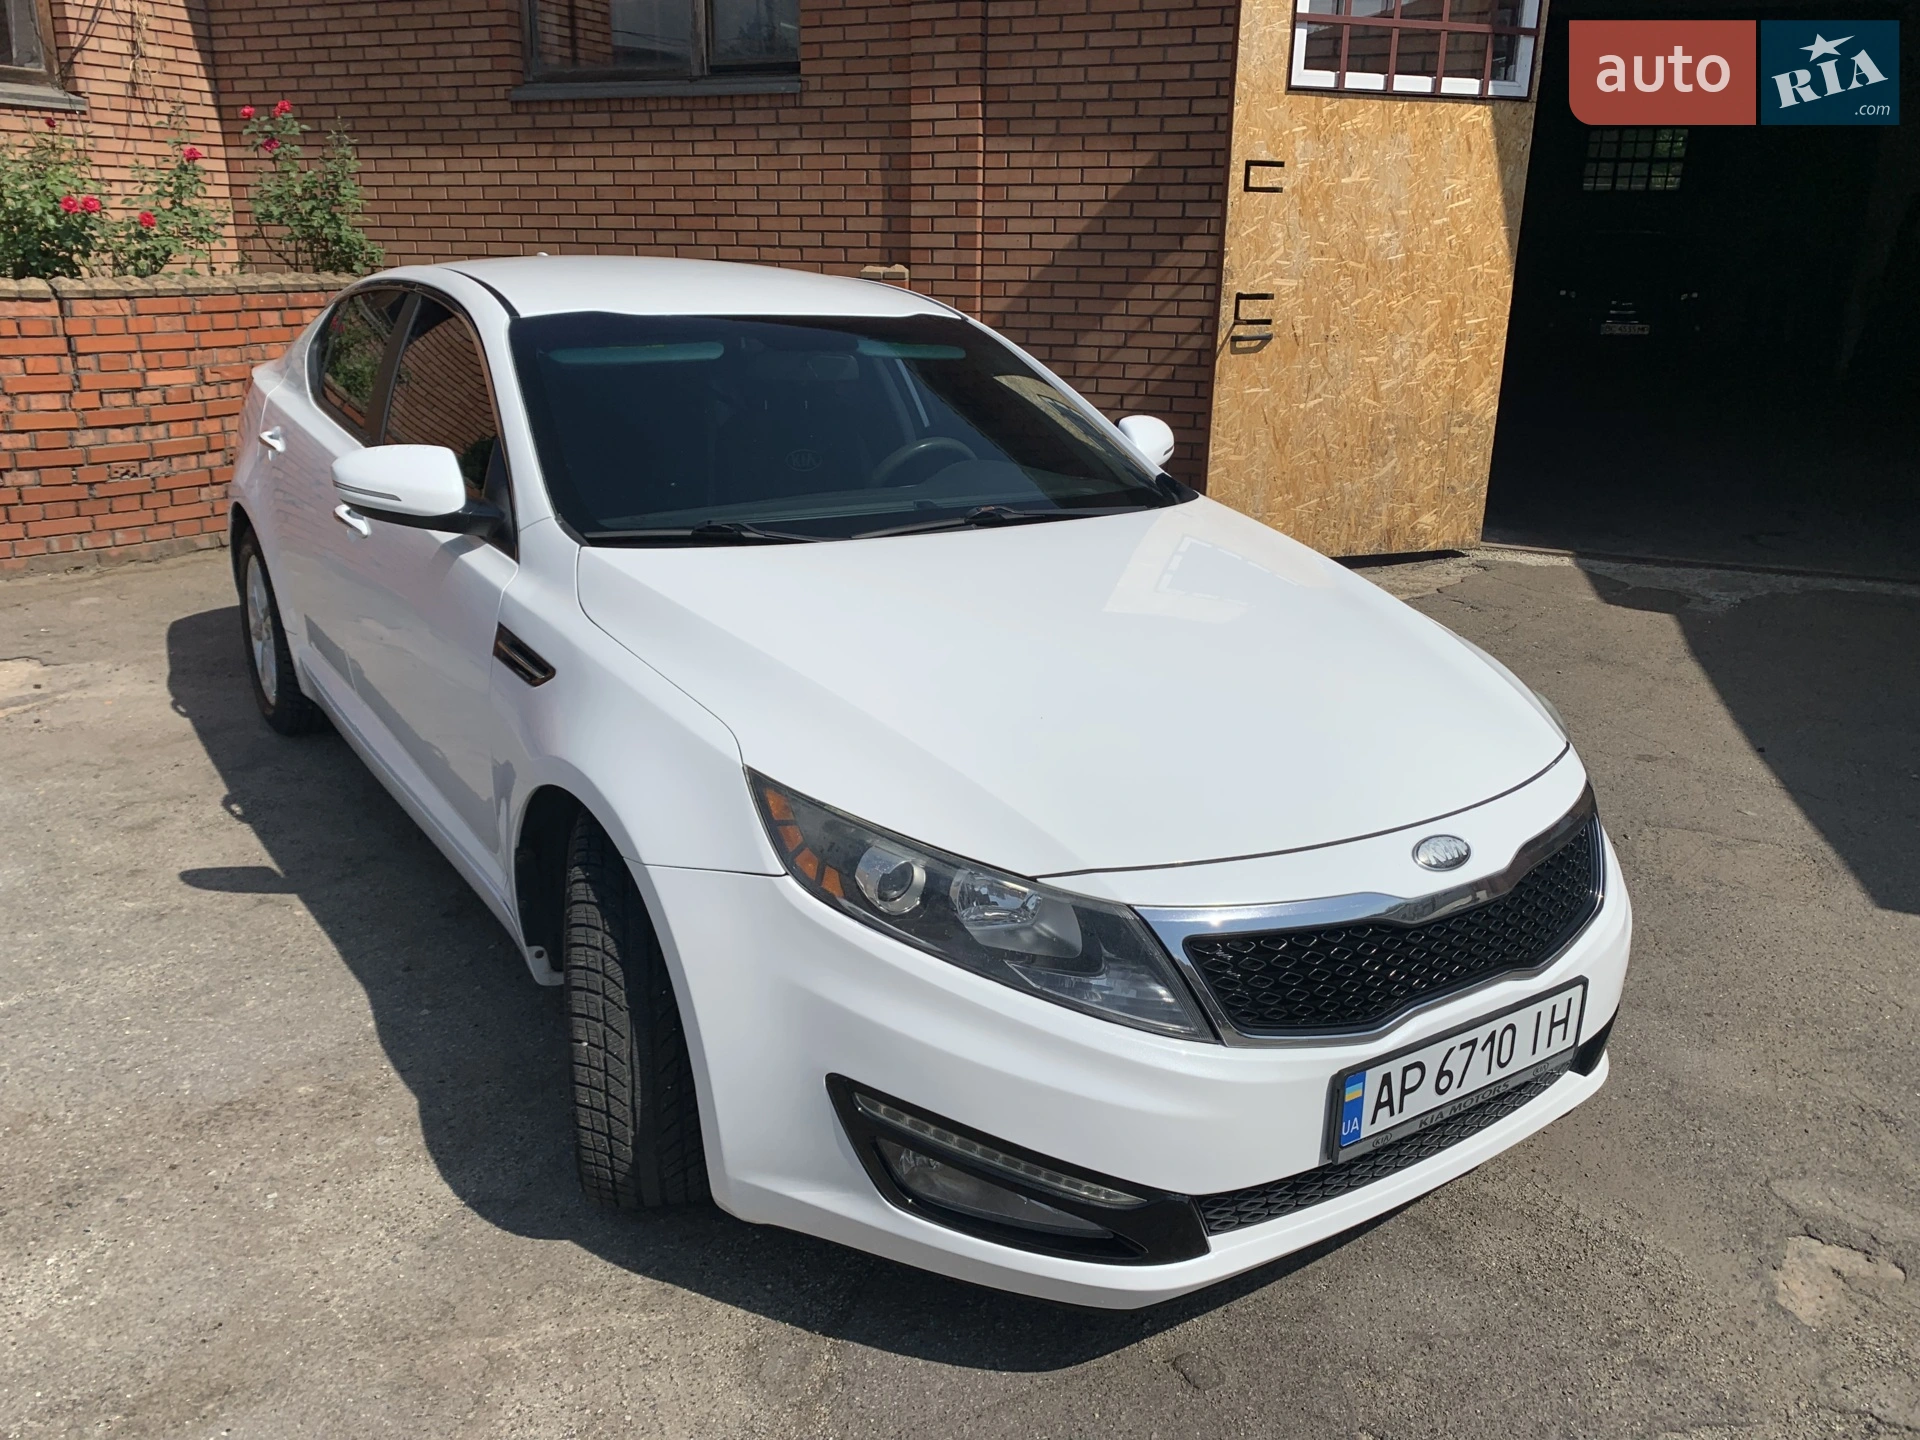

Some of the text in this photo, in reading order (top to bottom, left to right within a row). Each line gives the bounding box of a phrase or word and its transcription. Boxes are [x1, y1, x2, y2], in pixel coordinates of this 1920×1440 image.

[1370, 997, 1573, 1125] AP 6710 IH
[1418, 1080, 1510, 1129] KIA MOTORS
[1342, 1117, 1359, 1136] UA
[1374, 1134, 1391, 1148] KIA
